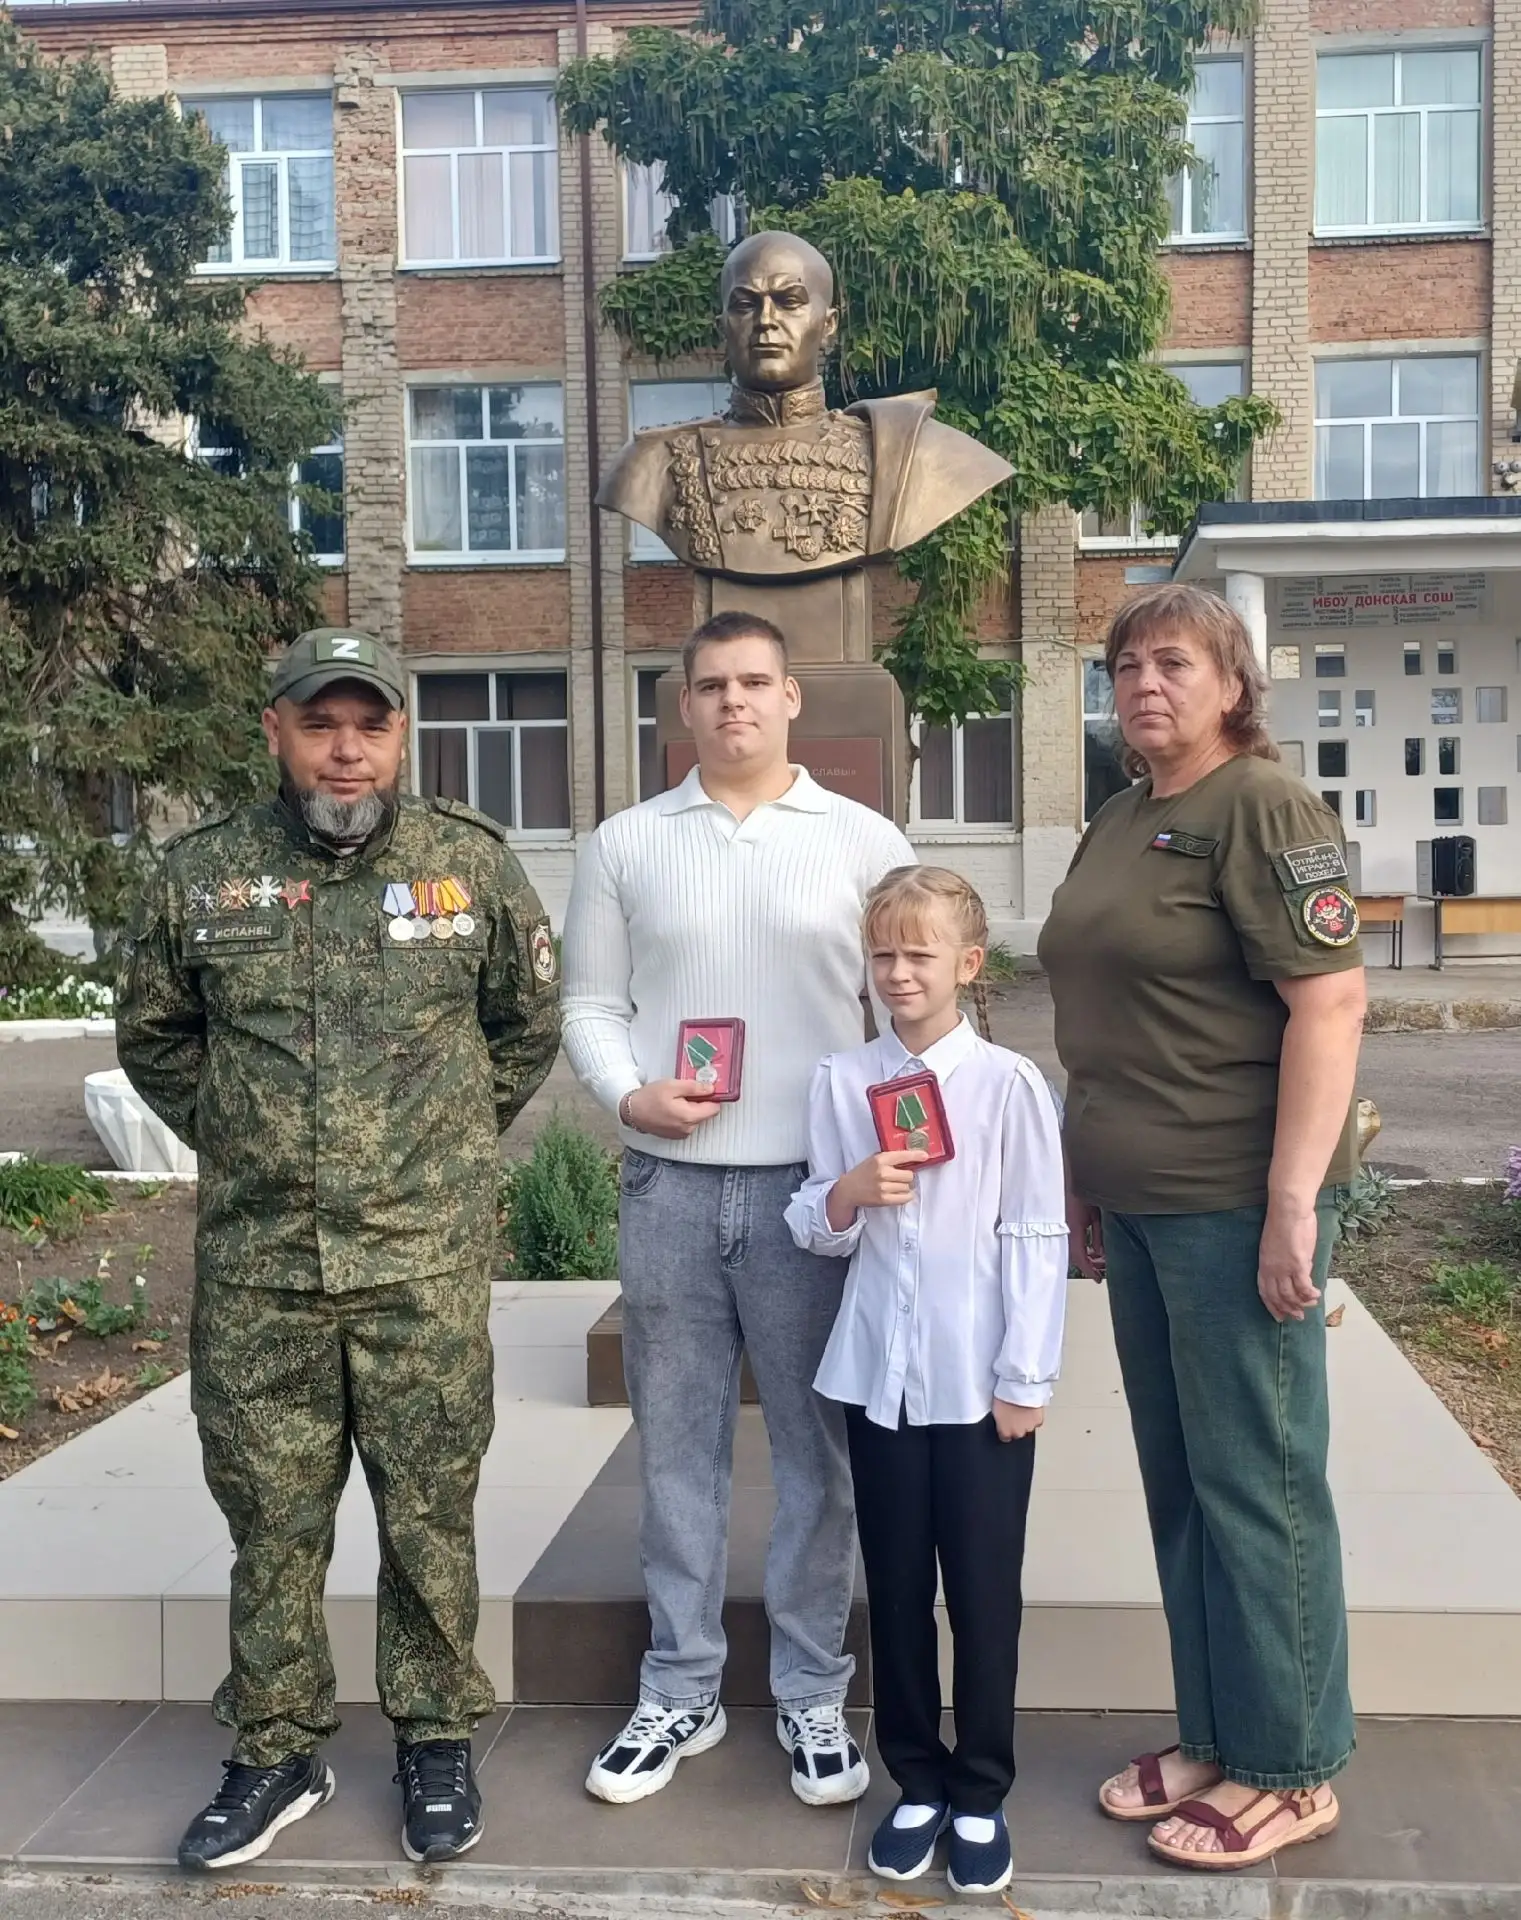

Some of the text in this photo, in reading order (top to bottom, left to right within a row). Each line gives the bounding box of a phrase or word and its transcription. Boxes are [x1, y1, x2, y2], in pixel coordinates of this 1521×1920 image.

[1313, 597, 1348, 608] МБОУ
[1355, 594, 1416, 608] ДОНСКАЯ
[1424, 592, 1453, 603] СОШ
[331, 637, 360, 658] Z
[1292, 852, 1339, 866] ОТЛИЧНО
[196, 925, 272, 940] Z ИСПАНЕЦ
[674, 1716, 696, 1738] N
